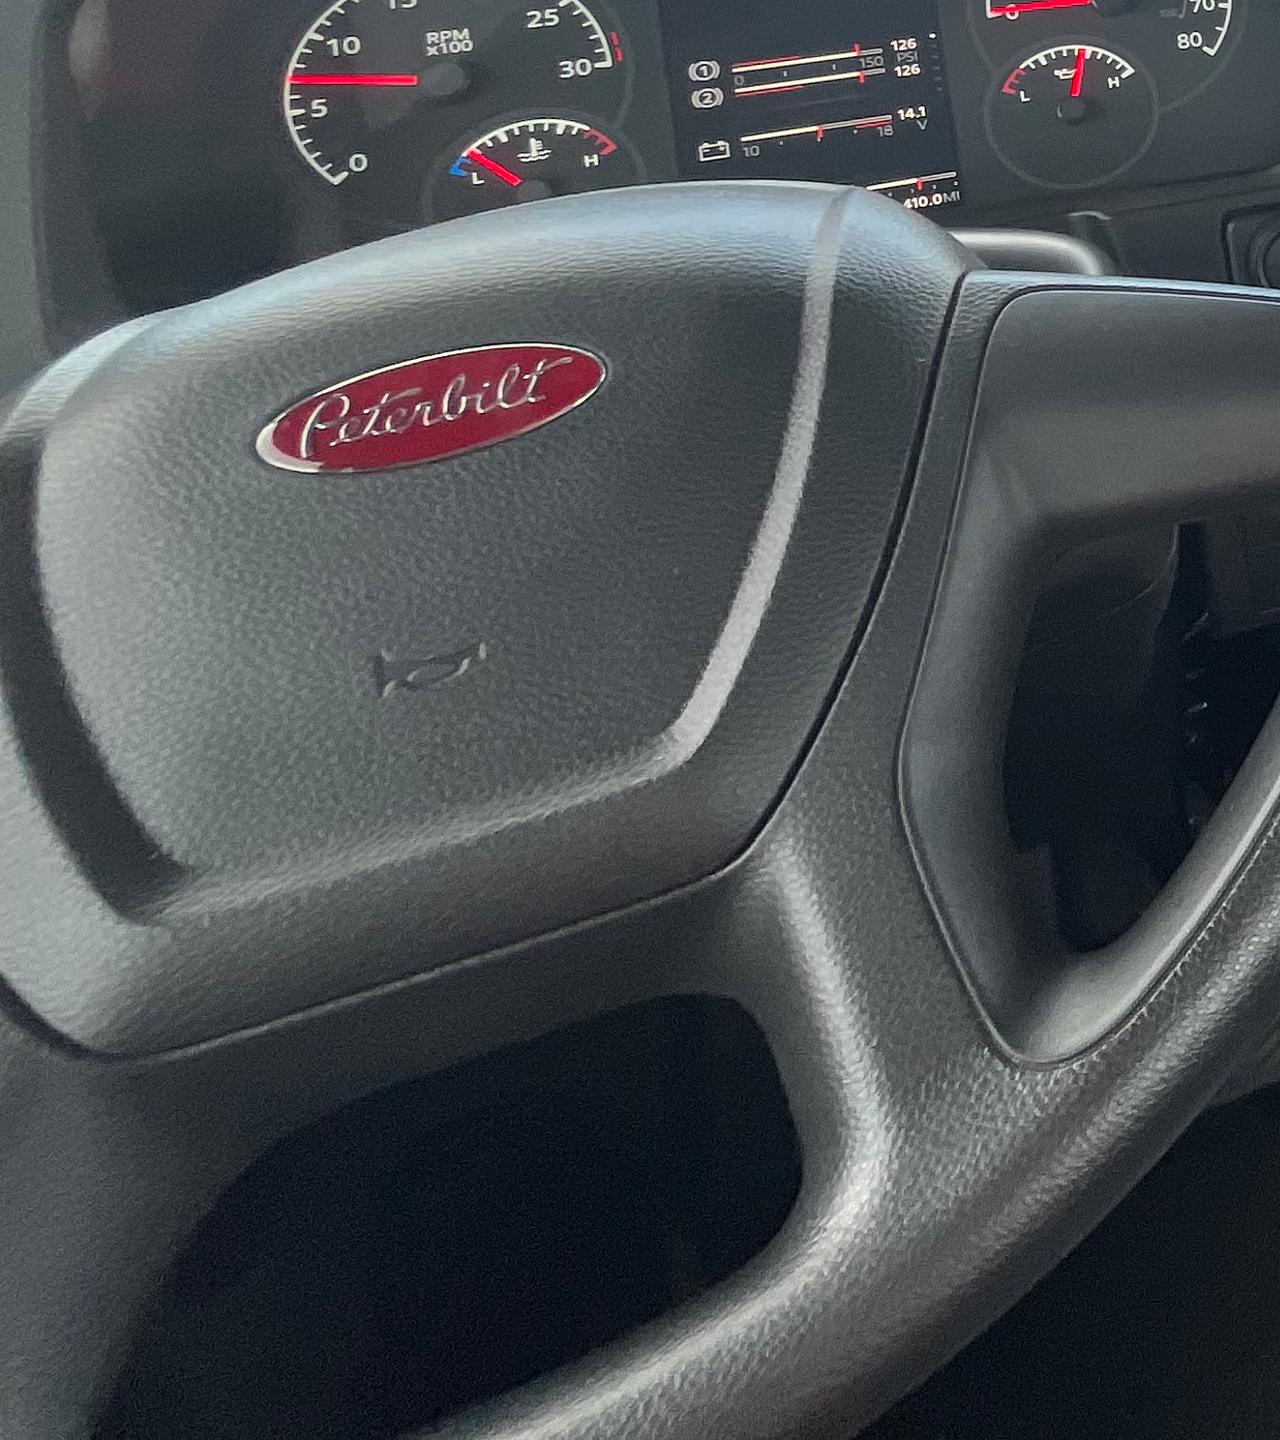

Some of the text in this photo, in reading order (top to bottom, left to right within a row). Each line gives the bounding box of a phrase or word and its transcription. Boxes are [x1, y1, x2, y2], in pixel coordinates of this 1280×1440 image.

[526, 9, 560, 29] 25
[426, 27, 470, 44] RPM
[1176, 32, 1203, 49] 80
[327, 36, 361, 57] 10
[890, 38, 917, 51] 126
[858, 56, 884, 68] 150
[897, 51, 918, 63] PSI
[558, 59, 592, 78] 30
[894, 64, 921, 77] 126
[1108, 77, 1120, 88] H
[1020, 90, 1030, 102] L
[311, 99, 328, 118] 5
[898, 106, 927, 120] 14.1
[877, 125, 894, 137] 18
[917, 119, 928, 130] V
[743, 145, 760, 157] 10
[350, 154, 368, 173] 0
[584, 154, 599, 168] H
[472, 172, 484, 185] L
[302, 356, 573, 459] Peterbilt
